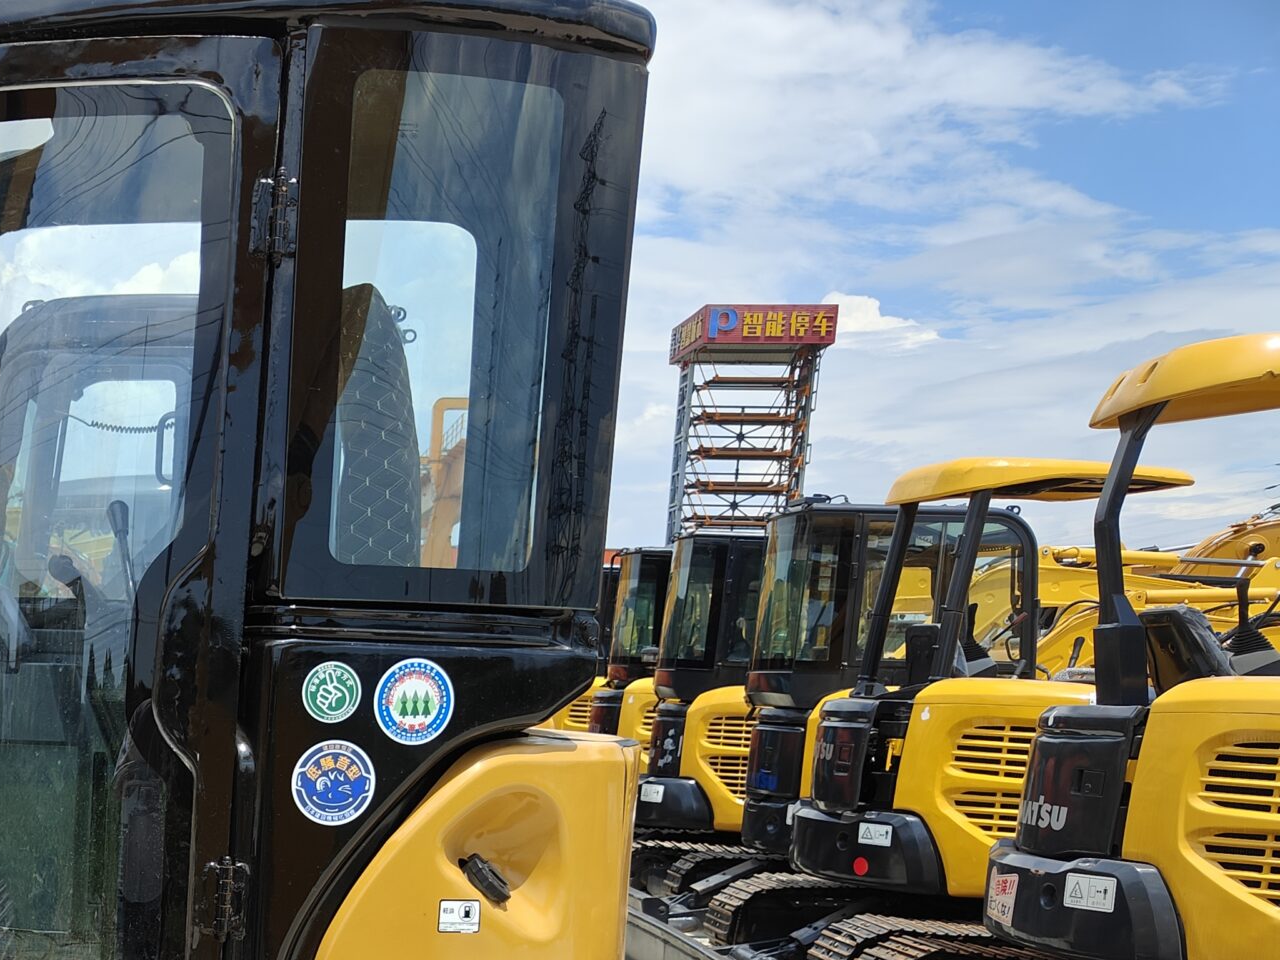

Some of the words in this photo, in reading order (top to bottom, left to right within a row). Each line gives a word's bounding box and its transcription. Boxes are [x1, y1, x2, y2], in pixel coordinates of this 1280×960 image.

[742, 311, 834, 337] 智能停车
[306, 755, 362, 782] 低騒音型
